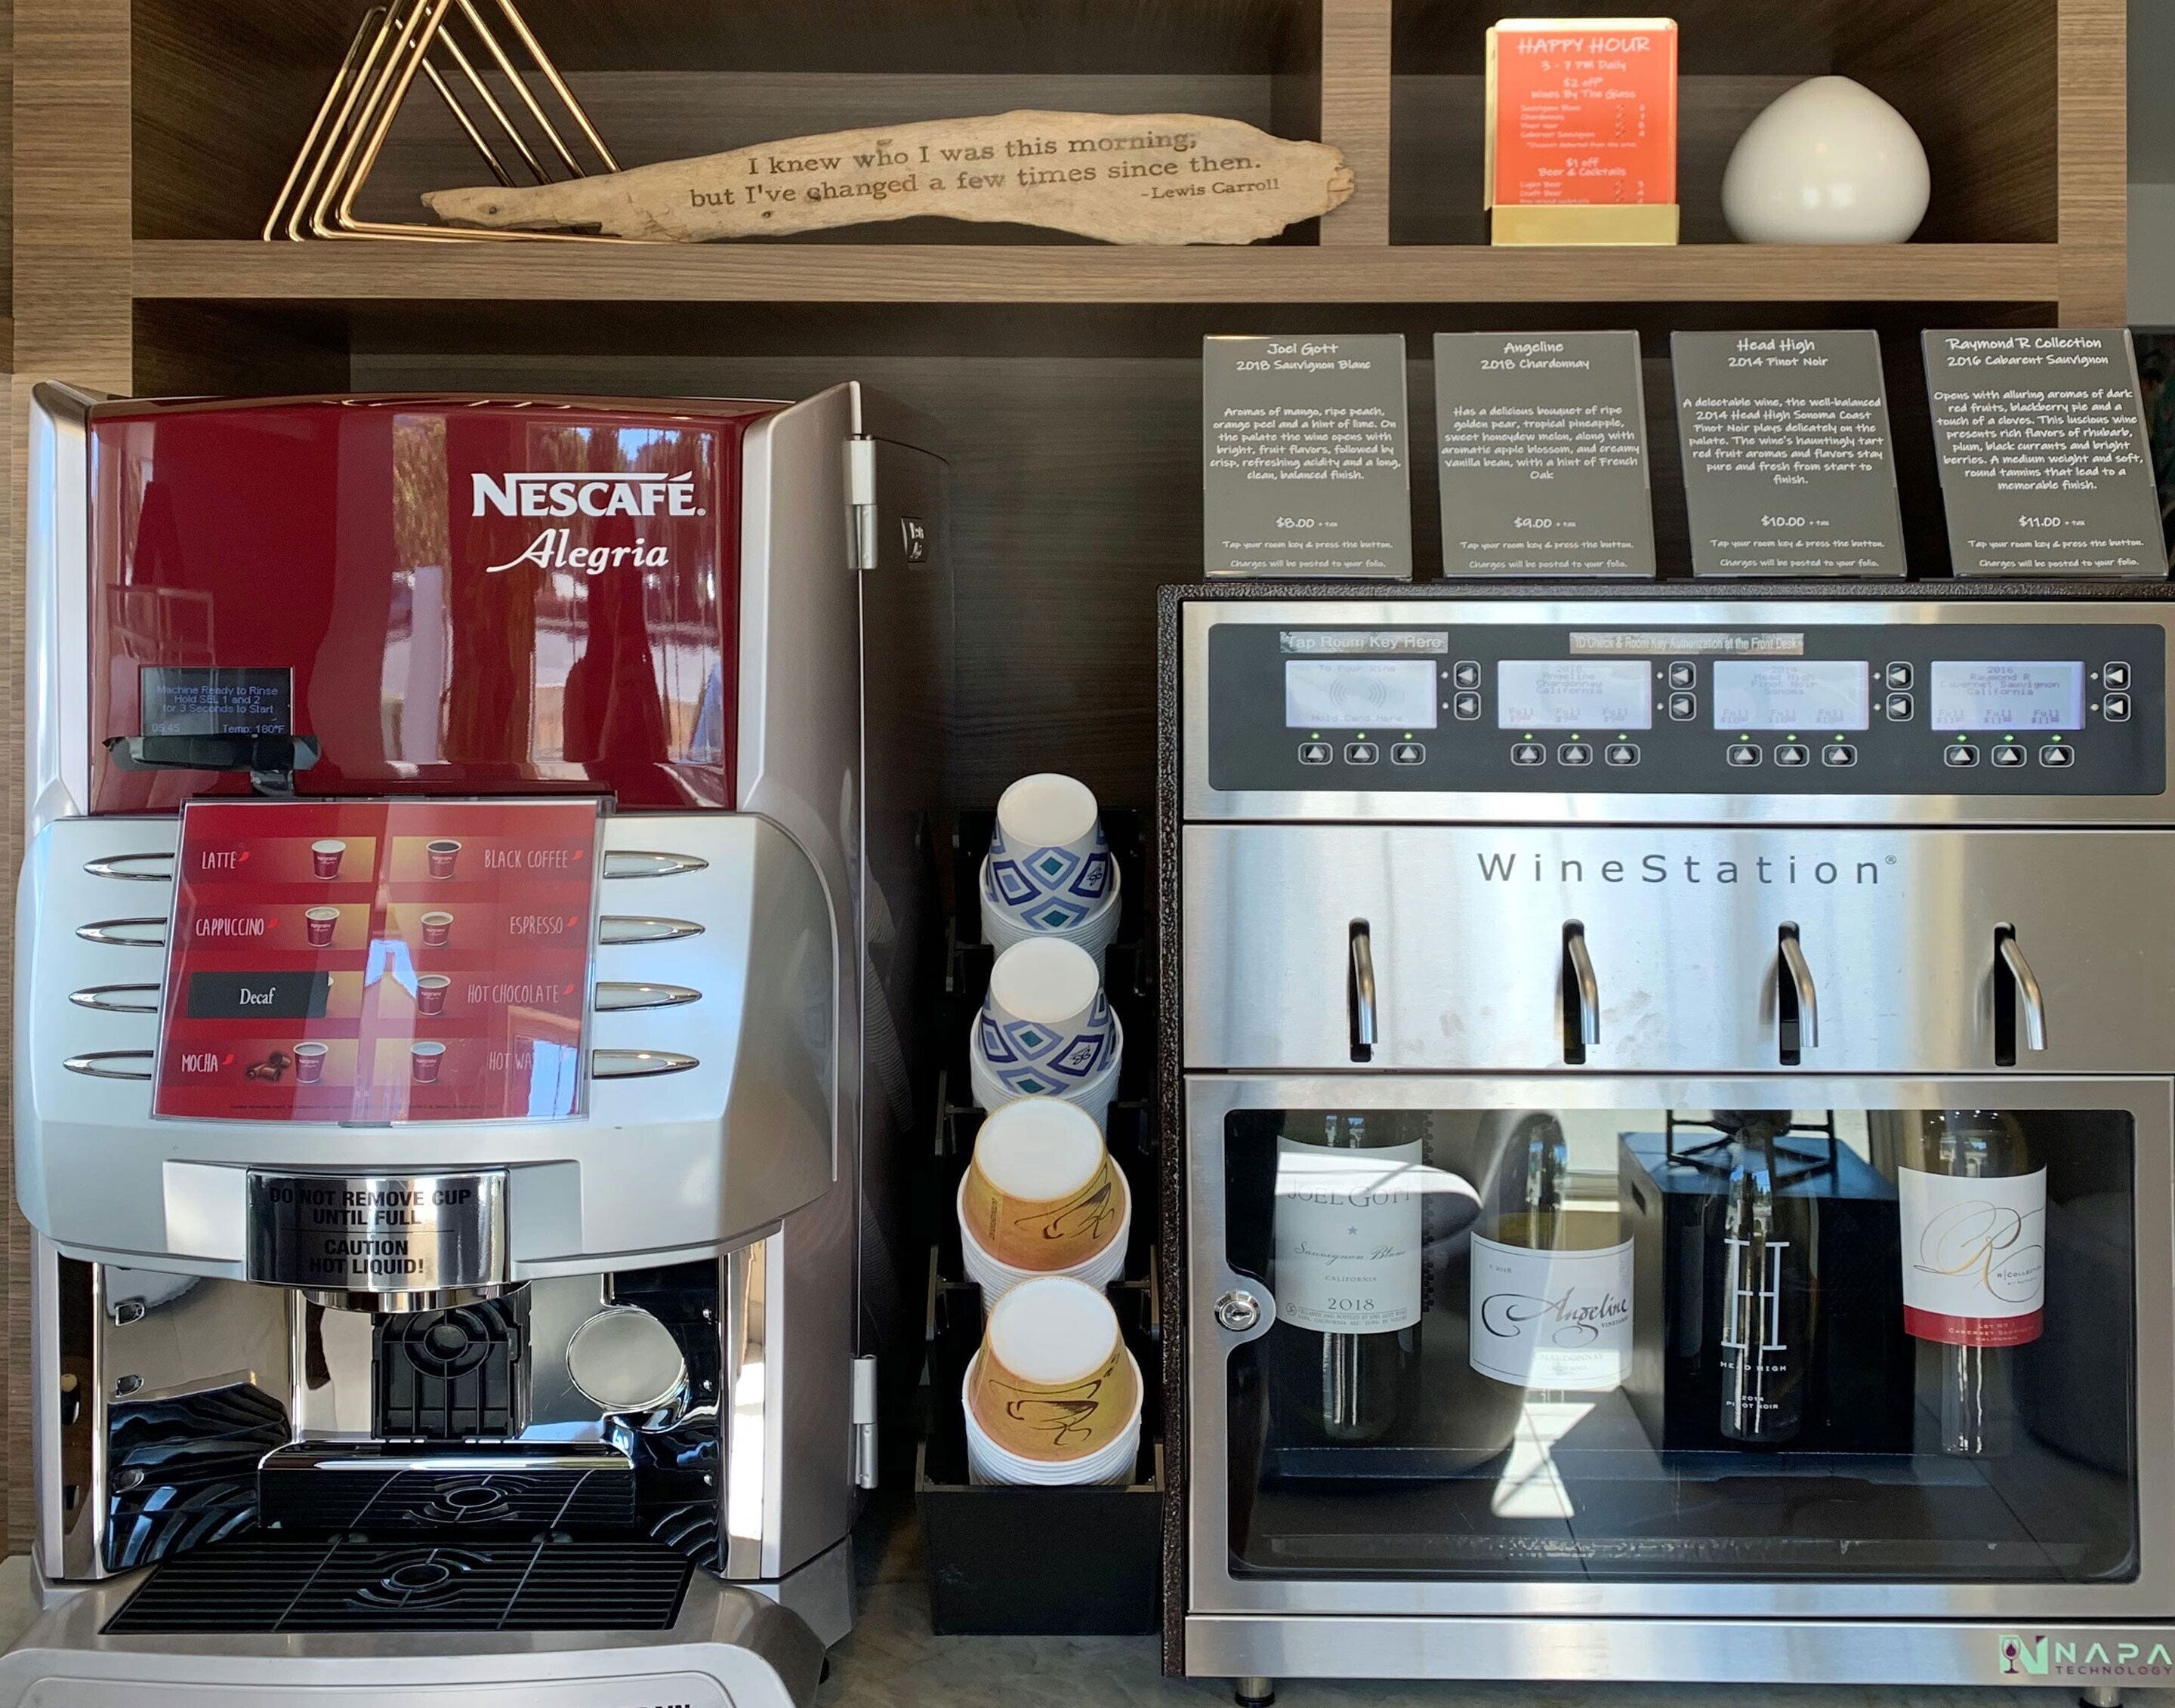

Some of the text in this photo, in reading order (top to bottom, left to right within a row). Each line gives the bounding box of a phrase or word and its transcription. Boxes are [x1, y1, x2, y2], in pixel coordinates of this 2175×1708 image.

[1517, 36, 1651, 54] HAPPY HOUR
[1598, 60, 1626, 72] Daily
[1563, 78, 1578, 87] $2
[749, 158, 758, 174] I
[770, 156, 841, 173] knew
[853, 150, 908, 168] who
[920, 146, 930, 163] I
[939, 145, 995, 162] was
[1004, 134, 1057, 157] this
[1566, 157, 1599, 167] $1 off
[1579, 168, 1626, 176] Cocktails
[690, 156, 1262, 207] but I've changed a few times since then.
[1212, 178, 1279, 195] Carroll
[1267, 343, 1338, 355] Joel Gott
[1504, 341, 1564, 356] Angeline
[1737, 338, 1815, 354] Head High
[1945, 337, 2102, 350] Raymond R Collection
[1236, 359, 1371, 372] 2018 Sauvignon Blanc
[1481, 359, 1590, 370] 2018 Chardonnay
[1728, 357, 1828, 367] 2014 Pinot Noir
[1947, 354, 2109, 367] 2016 Cabarent Sauvignon
[1934, 389, 2133, 402] Opens with alluring aromas of dark
[1683, 397, 1881, 408] A delectable wine, the well-balanced
[1948, 402, 1967, 412] red
[1970, 402, 2007, 412] fruits,
[2010, 402, 2068, 413] blackberry
[2072, 402, 2088, 412] pie
[2092, 402, 2112, 411] and
[1224, 407, 1385, 418] Aromas of mango, ripe peach,
[1453, 407, 1476, 417] Has
[1490, 406, 1534, 415] delicious
[1537, 406, 1582, 418] bouquet
[1585, 405, 1597, 415] of
[1600, 405, 1622, 418] ripe
[470, 470, 697, 517] NESCAFÉ
[1276, 517, 1314, 529] $8.00
[1514, 517, 1552, 529] $9.00
[1761, 516, 1805, 527] $10.00
[2019, 516, 2061, 527] $11.00
[486, 529, 668, 575] Alegria
[1289, 636, 1441, 649] Tap Room Key Here
[1576, 637, 1585, 648] ID
[1735, 637, 1749, 649] the
[1751, 637, 1773, 649] Front
[157, 686, 278, 696] Machine Ready to Rinse
[162, 704, 274, 713] for 3 Seconds to Start
[223, 724, 251, 735] Temp:
[201, 851, 237, 870] LATTE
[485, 849, 569, 868] BLACK COFFEE
[1477, 852, 1880, 885] WineStation
[196, 917, 264, 936] CAPPUCCINO
[510, 916, 563, 935] ESPRESSO
[239, 988, 276, 1005] Decaf
[467, 985, 559, 1003] HOT CHOCOLATE
[181, 1053, 218, 1073] MOCHA
[489, 1052, 510, 1071] HOT
[270, 1188, 471, 1207] DO NOT REMOVE CUP
[313, 1210, 422, 1225] UNTIL FULL
[324, 1240, 409, 1255] CAUTION
[1294, 1241, 1406, 1266] Sauvignon Blanc
[309, 1259, 424, 1275] HOT LIQUID!
[1328, 1298, 1374, 1311] 2018
[1482, 1287, 1629, 1349] Angeline
[1720, 1361, 1751, 1371] HED
[2055, 1642, 2173, 1665] NAPA
[2056, 1666, 2173, 1675] TECHNOLOGY
